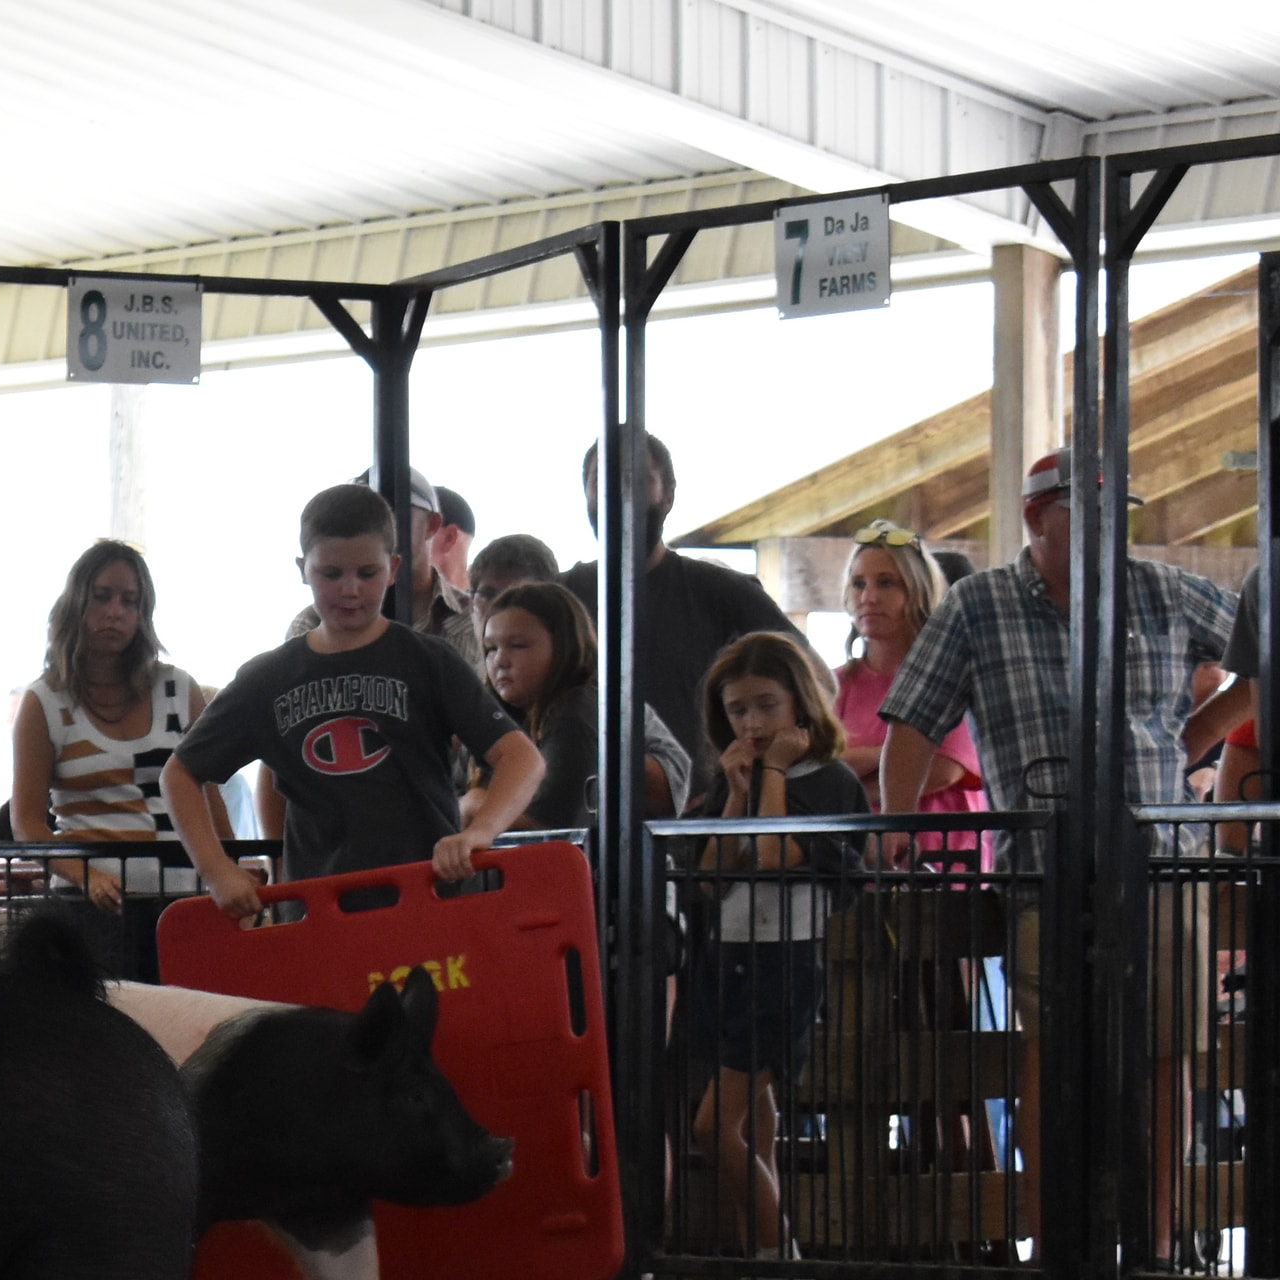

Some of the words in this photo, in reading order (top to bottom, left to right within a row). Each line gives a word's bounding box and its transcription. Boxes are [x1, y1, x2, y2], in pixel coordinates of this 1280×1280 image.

[824, 216, 844, 236] Da
[851, 212, 869, 232] Ja
[784, 219, 809, 305] 7
[818, 271, 876, 298] FARMS
[124, 294, 178, 315] J.B.S.
[79, 290, 107, 371] 8
[112, 321, 189, 347] UNITED,
[130, 350, 171, 369] INC.
[273, 674, 409, 736] CHAMPION
